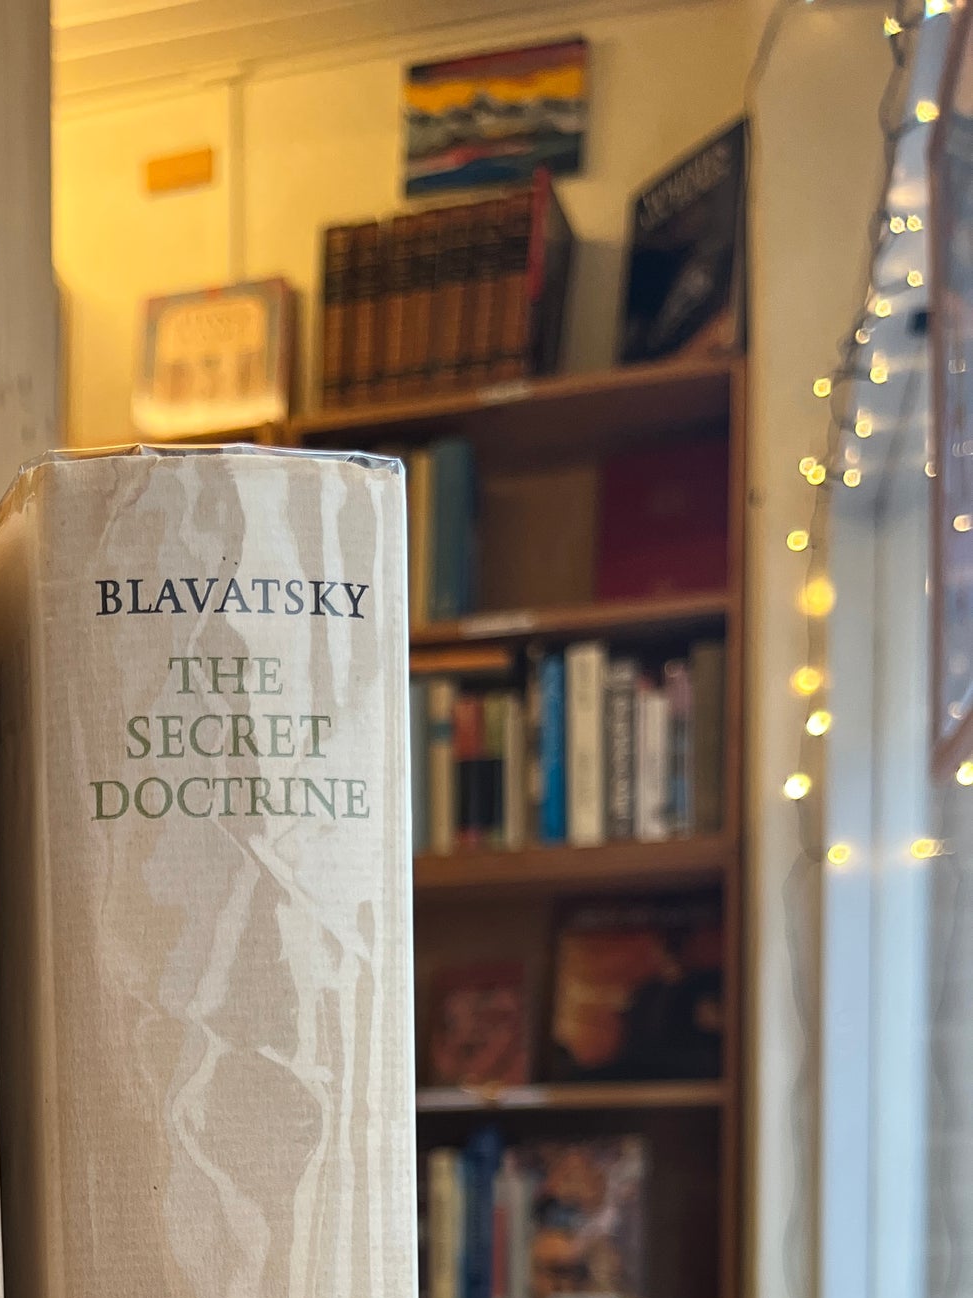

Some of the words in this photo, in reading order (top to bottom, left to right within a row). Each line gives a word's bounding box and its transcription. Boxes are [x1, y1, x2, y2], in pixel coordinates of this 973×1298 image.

[95, 578, 370, 620] BLAVATSKY
[168, 656, 284, 696] THE
[126, 714, 332, 760] SECRET
[89, 777, 371, 822] DOCTRINE
